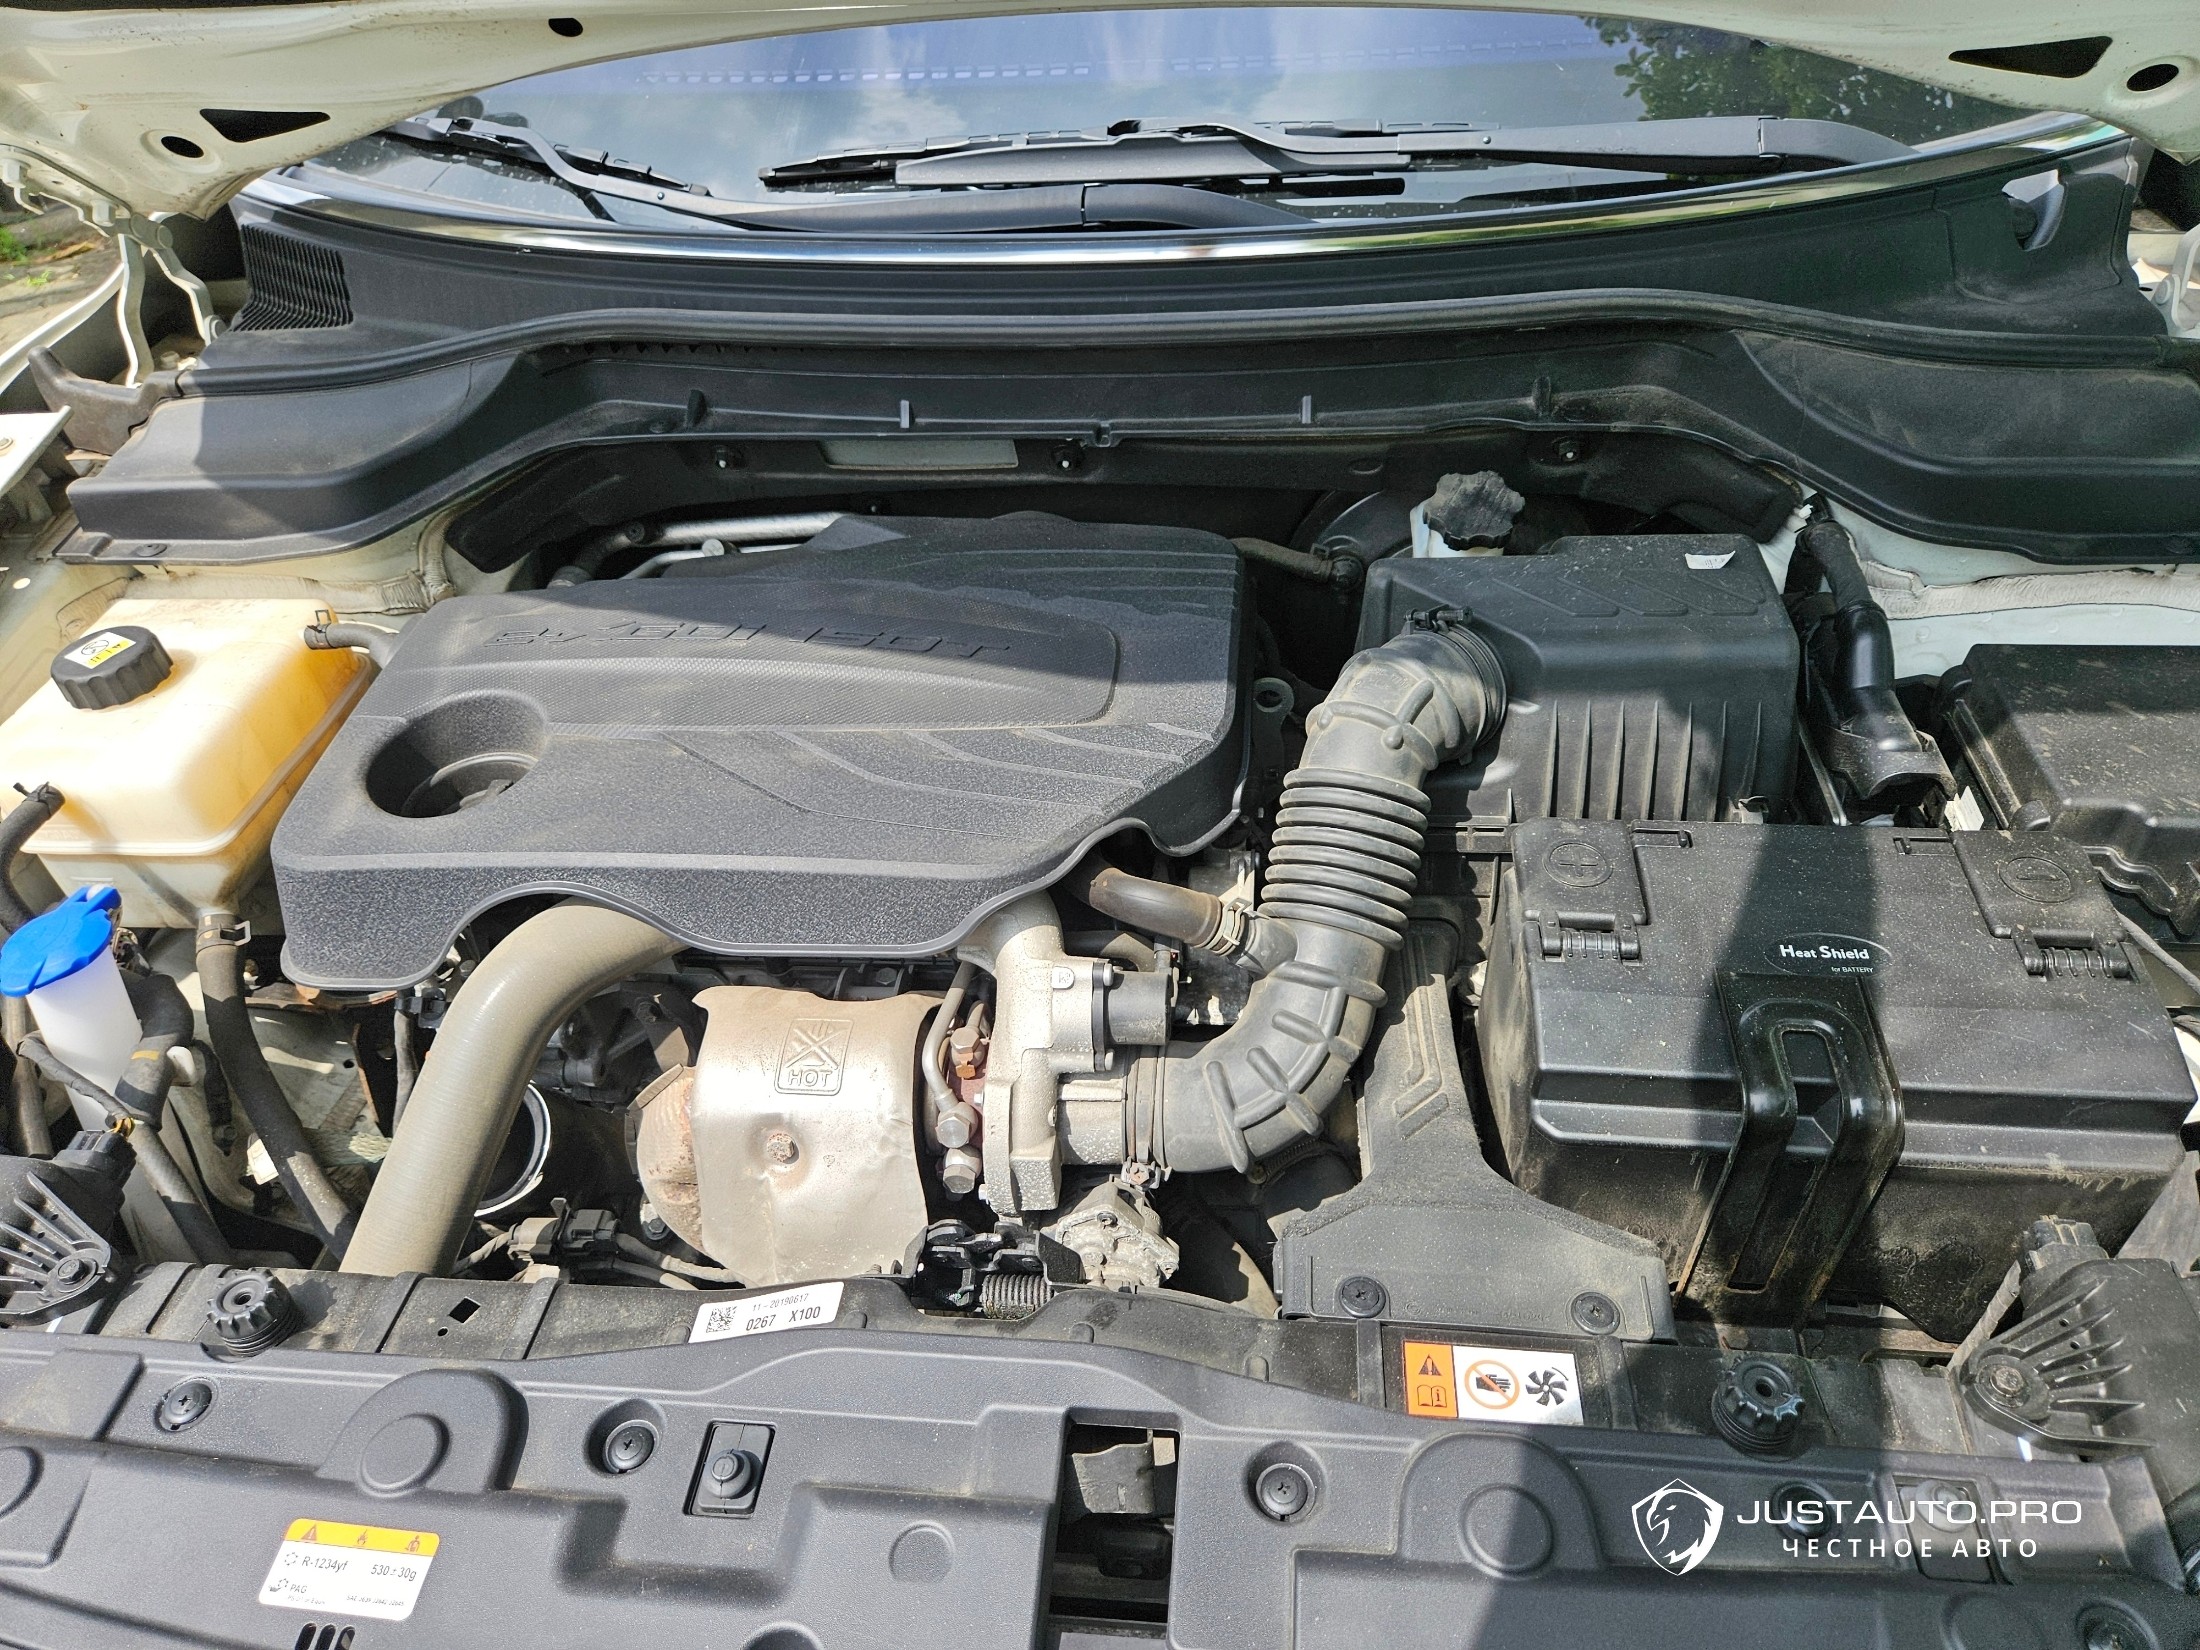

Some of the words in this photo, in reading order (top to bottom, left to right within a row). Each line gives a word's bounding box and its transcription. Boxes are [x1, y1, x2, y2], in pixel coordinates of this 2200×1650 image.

[1780, 944, 1818, 958] Heat
[1819, 945, 1870, 959] Shield
[788, 1069, 833, 1087] HOT
[745, 1314, 777, 1331] 0267
[789, 1306, 821, 1322] X100
[301, 1556, 348, 1573] R-1234yf
[290, 1584, 307, 1594] PAG
